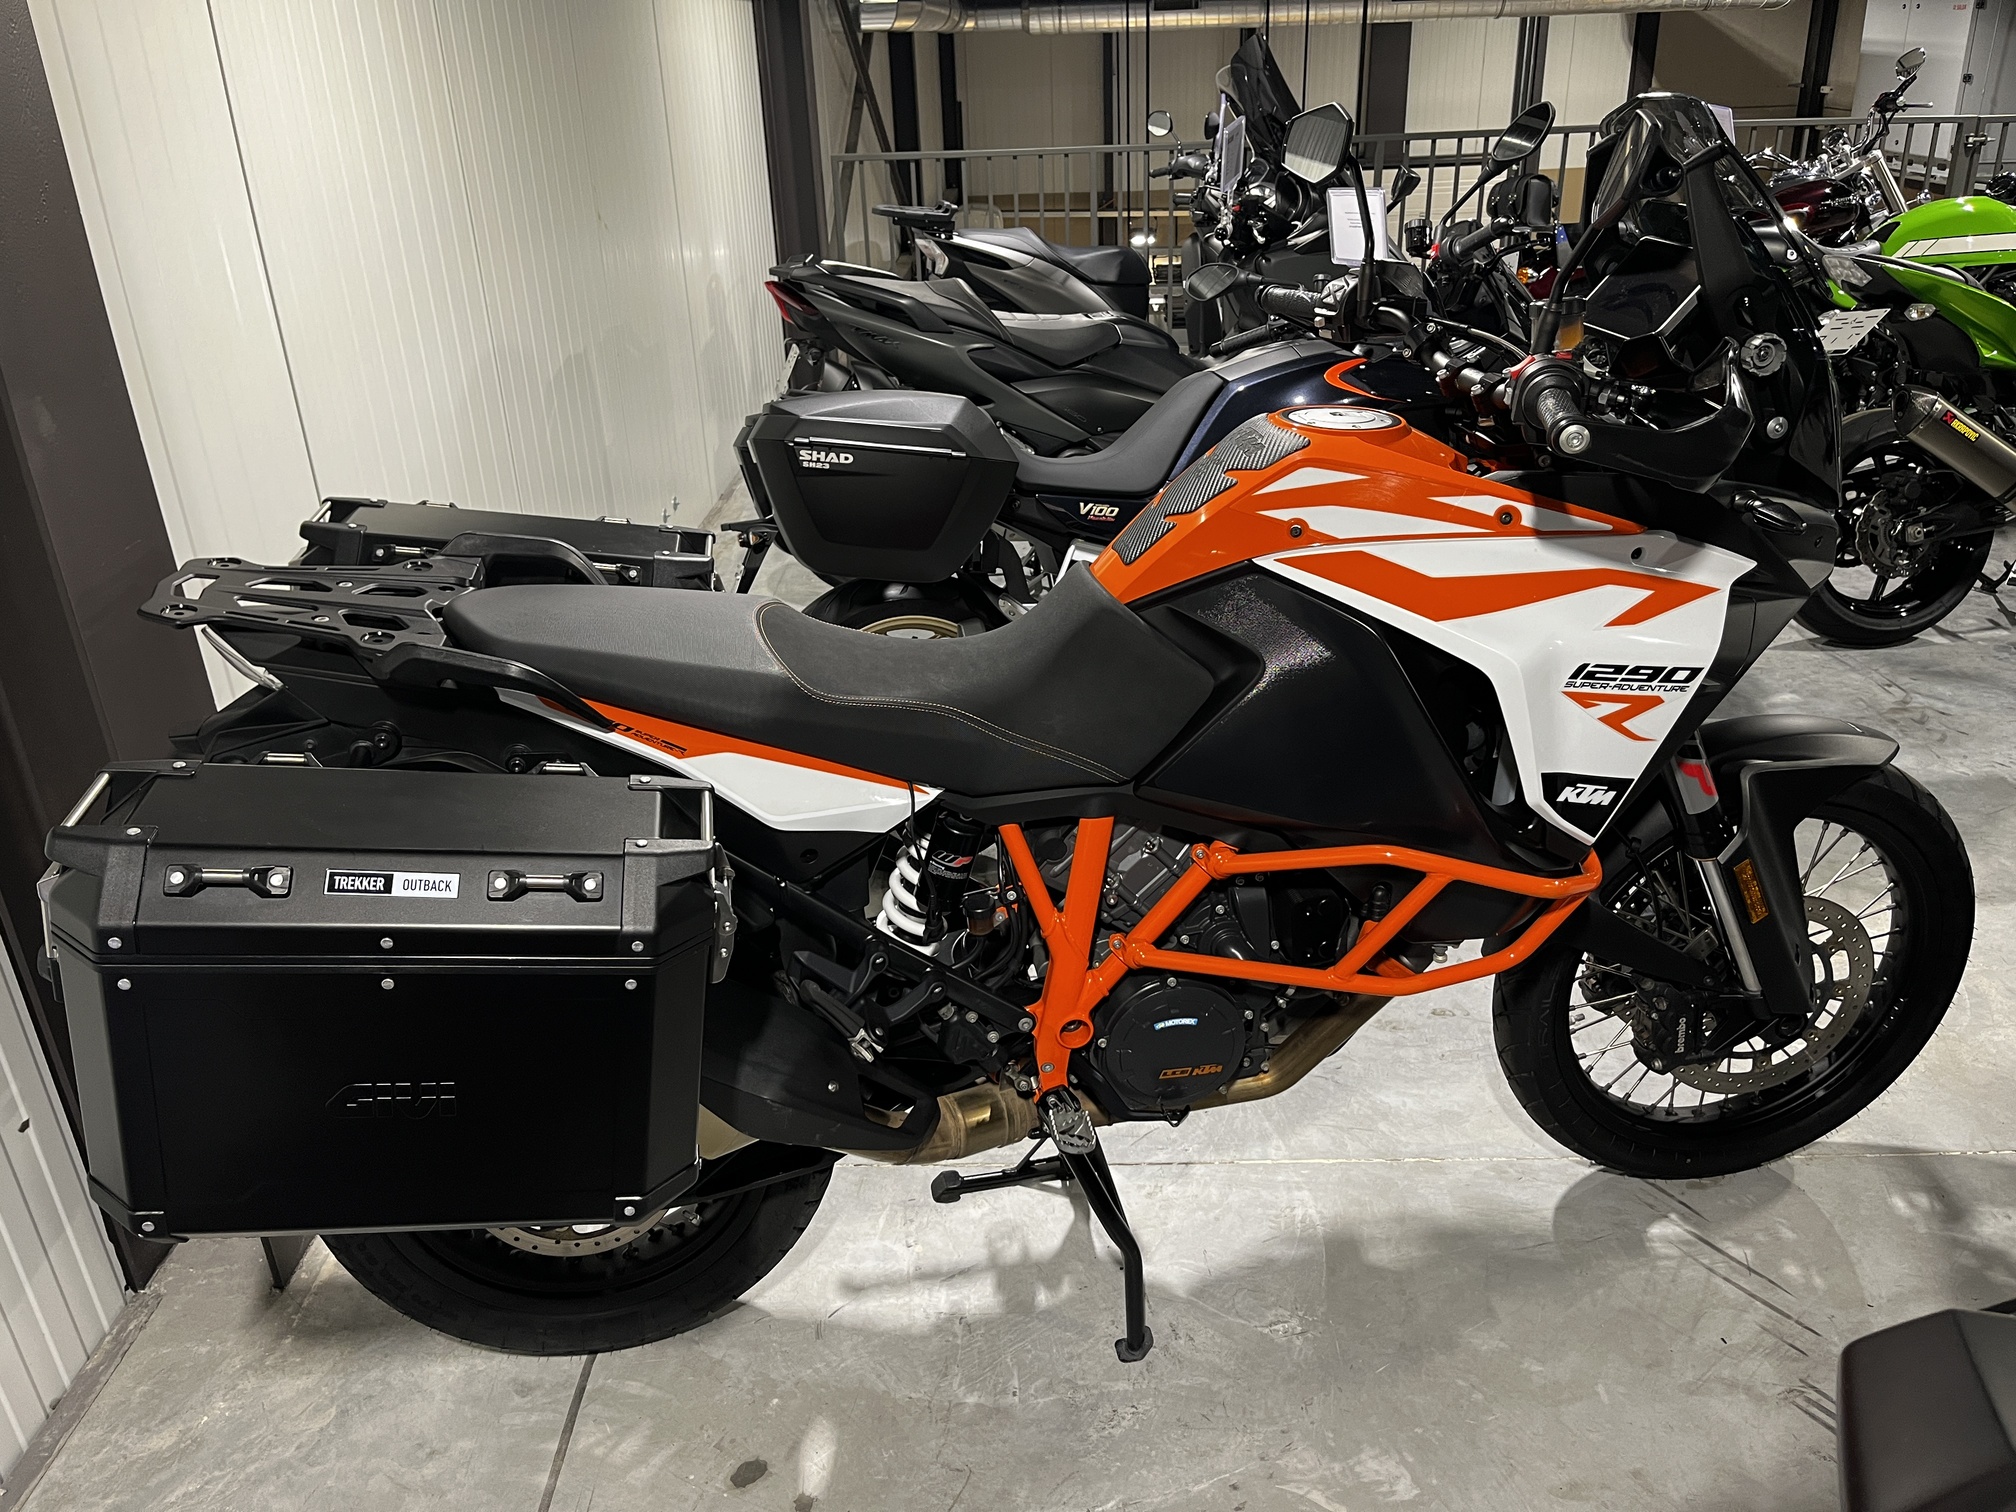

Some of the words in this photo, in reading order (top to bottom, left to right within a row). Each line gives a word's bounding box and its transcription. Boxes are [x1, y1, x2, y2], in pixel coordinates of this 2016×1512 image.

[799, 449, 854, 464] SHAD
[802, 461, 830, 470] SH23
[1079, 502, 1120, 517] V100
[1567, 662, 1705, 684] 1290
[1563, 680, 1690, 693] SUPER-ADVENTURE
[1555, 783, 1617, 806] KTM
[333, 875, 385, 891] TREKKER
[402, 878, 452, 892] OUTBACK
[1674, 1017, 1687, 1054] brembo
[1192, 1063, 1223, 1076] KTM
[325, 1081, 457, 1120] GIVI
